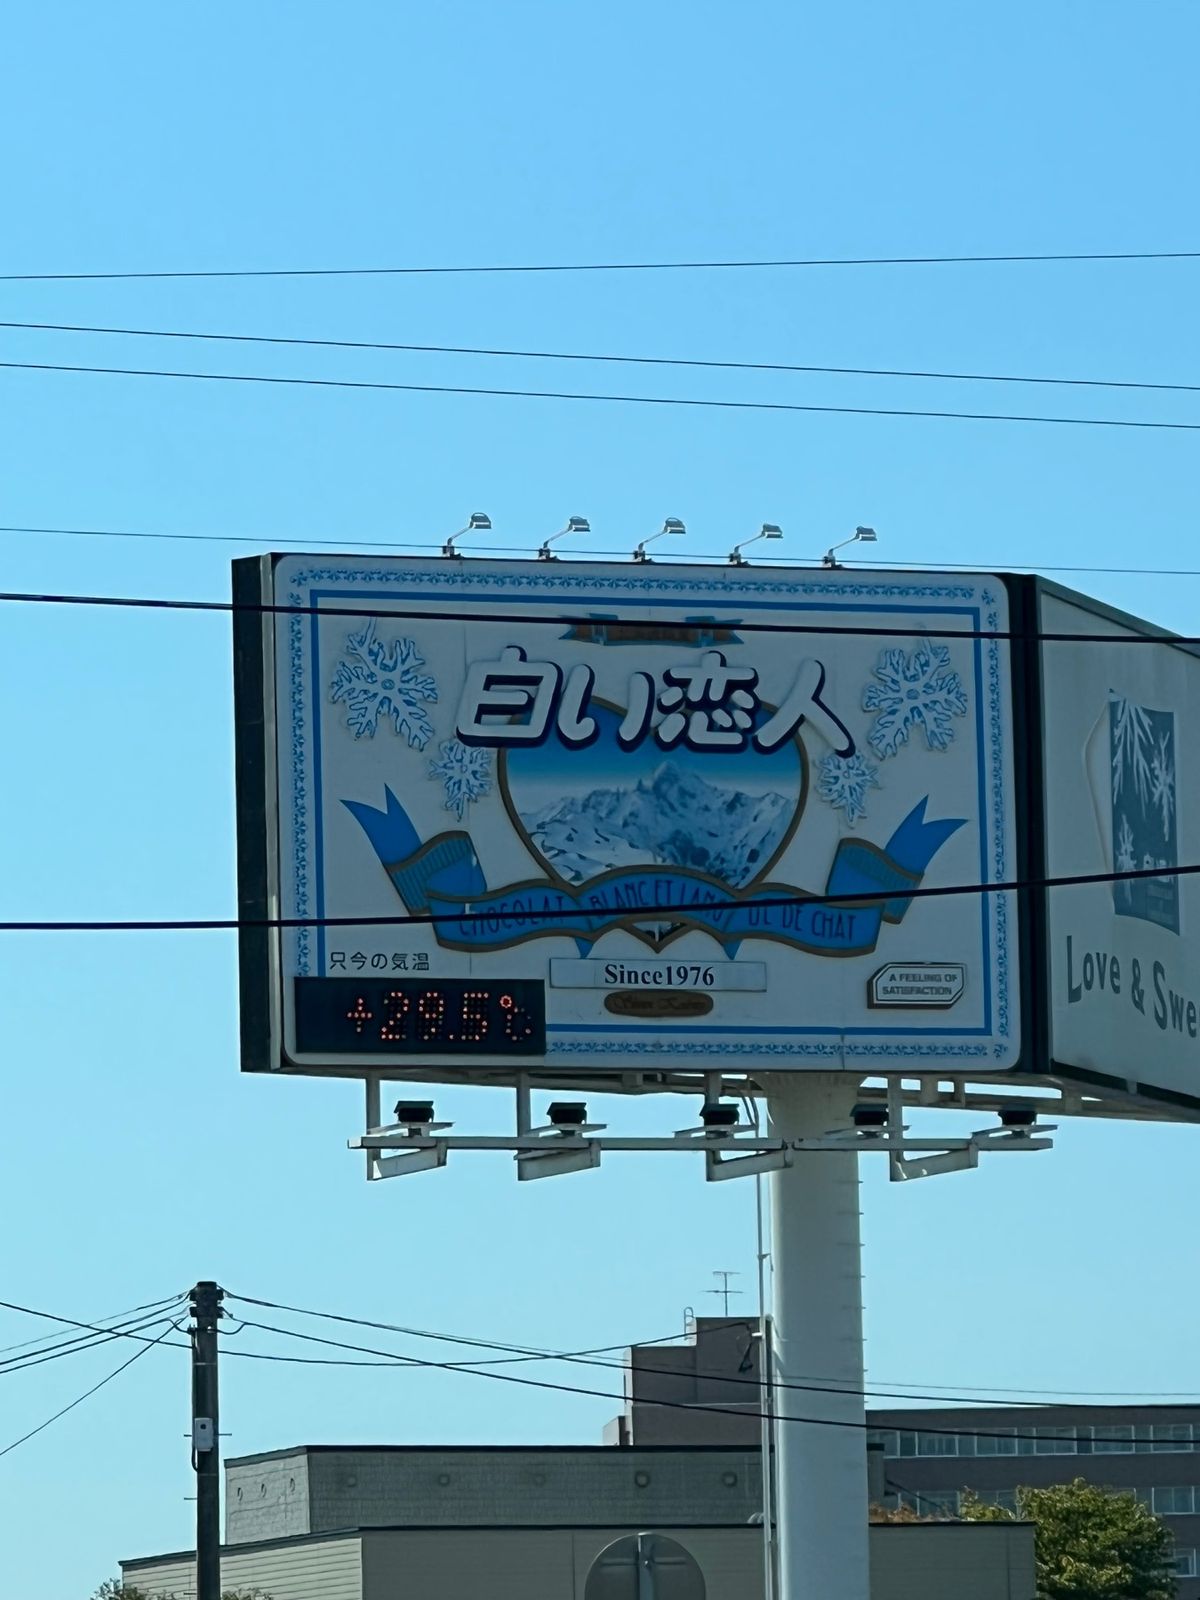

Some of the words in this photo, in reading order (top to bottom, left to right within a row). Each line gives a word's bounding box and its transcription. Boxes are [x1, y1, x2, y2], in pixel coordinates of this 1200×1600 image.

[456, 645, 856, 757] 白い恋人
[811, 910, 857, 942] CHAT
[329, 952, 430, 971] 只今の気温
[889, 973, 897, 982] A
[944, 973, 958, 982] OF
[1066, 935, 1121, 1004] Love
[1131, 957, 1146, 1016] &
[1152, 960, 1200, 1038] Swe
[882, 986, 952, 995] SATISFACTION
